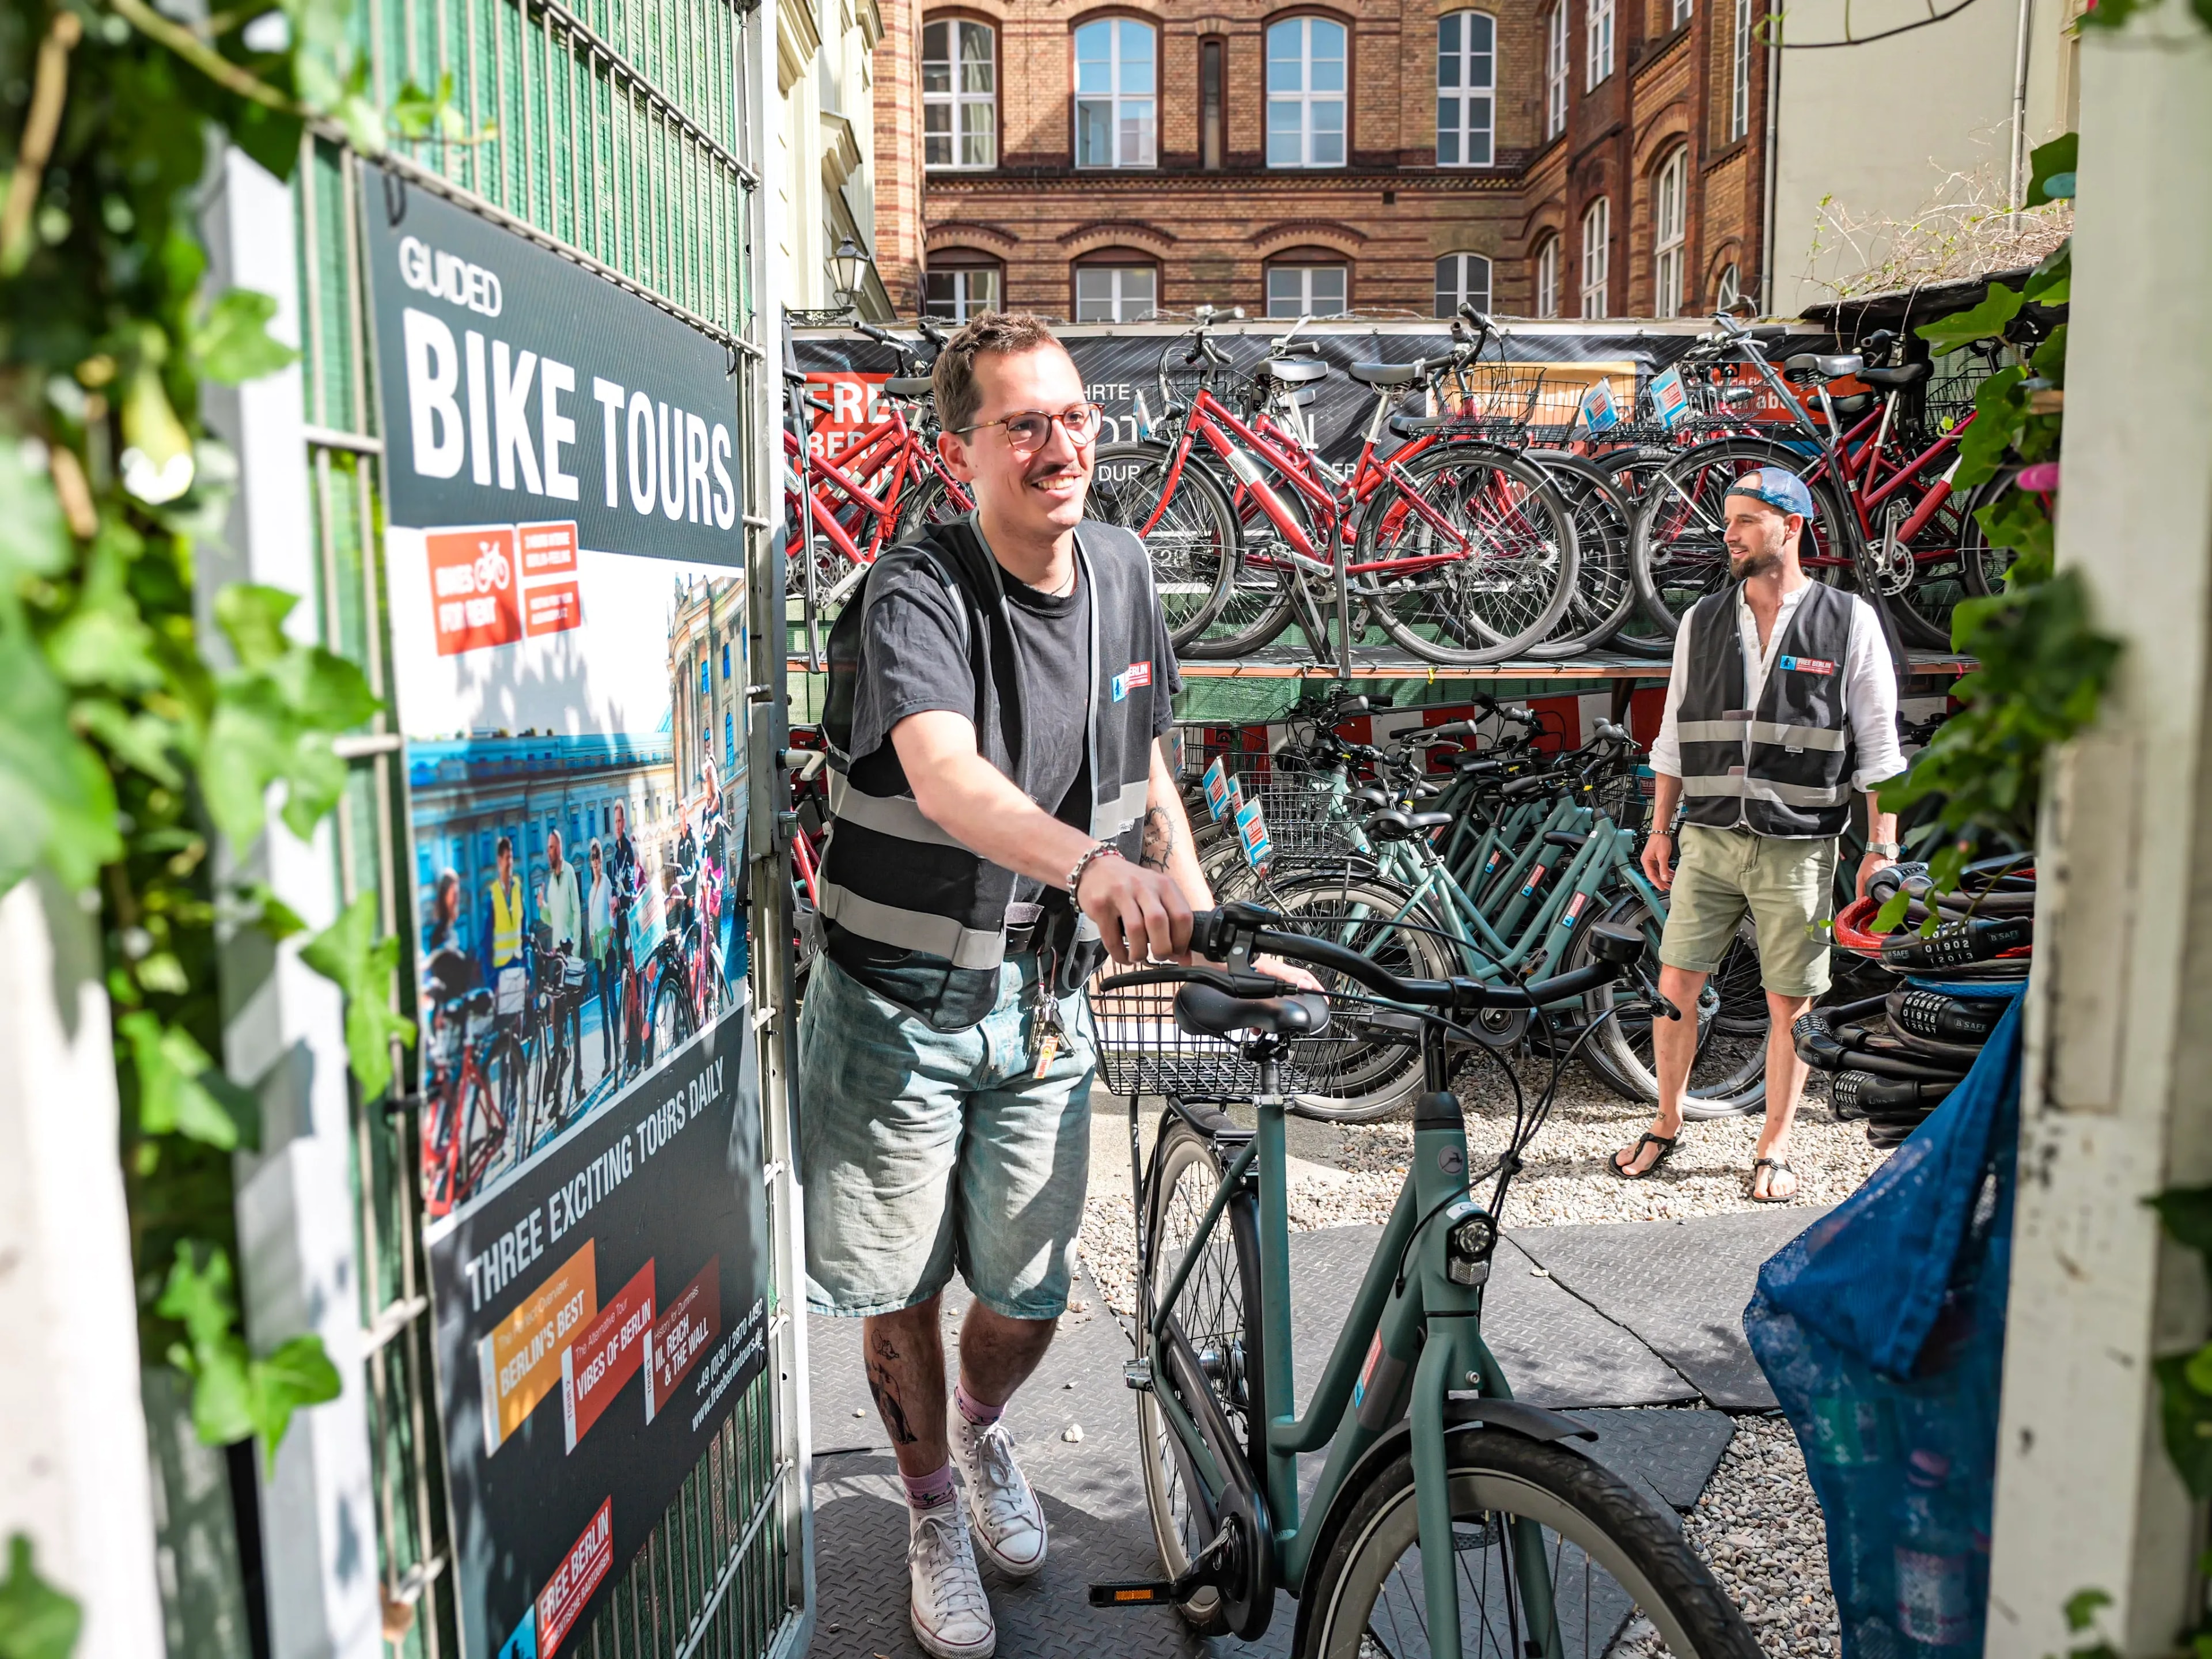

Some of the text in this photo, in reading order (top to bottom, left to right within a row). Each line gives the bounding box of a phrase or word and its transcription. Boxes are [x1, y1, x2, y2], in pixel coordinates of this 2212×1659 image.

[399, 237, 502, 317] GUIDED
[403, 307, 736, 531] BIKE TOURS
[1084, 384, 1130, 400] HRTE
[1128, 664, 1148, 677] ERLIN
[1812, 660, 1832, 669] BERLIN
[465, 1056, 724, 1312] THREE EXCITING TOURS DAILY
[500, 1289, 585, 1398] BERLIN'S BEST
[575, 1297, 628, 1362] The Alternative Tour
[576, 1298, 652, 1401] VIBES OF BERLIN
[654, 1317, 671, 1343] History
[655, 1313, 690, 1372] III. REICH
[664, 1317, 709, 1387] & THE WALL
[696, 1298, 763, 1397] +49 (0)30 / 2870 4492
[692, 1326, 764, 1433] www.freeberlintours.de
[540, 1506, 609, 1632] FREE BERLIN
[581, 1550, 610, 1601] RADTOUREN
